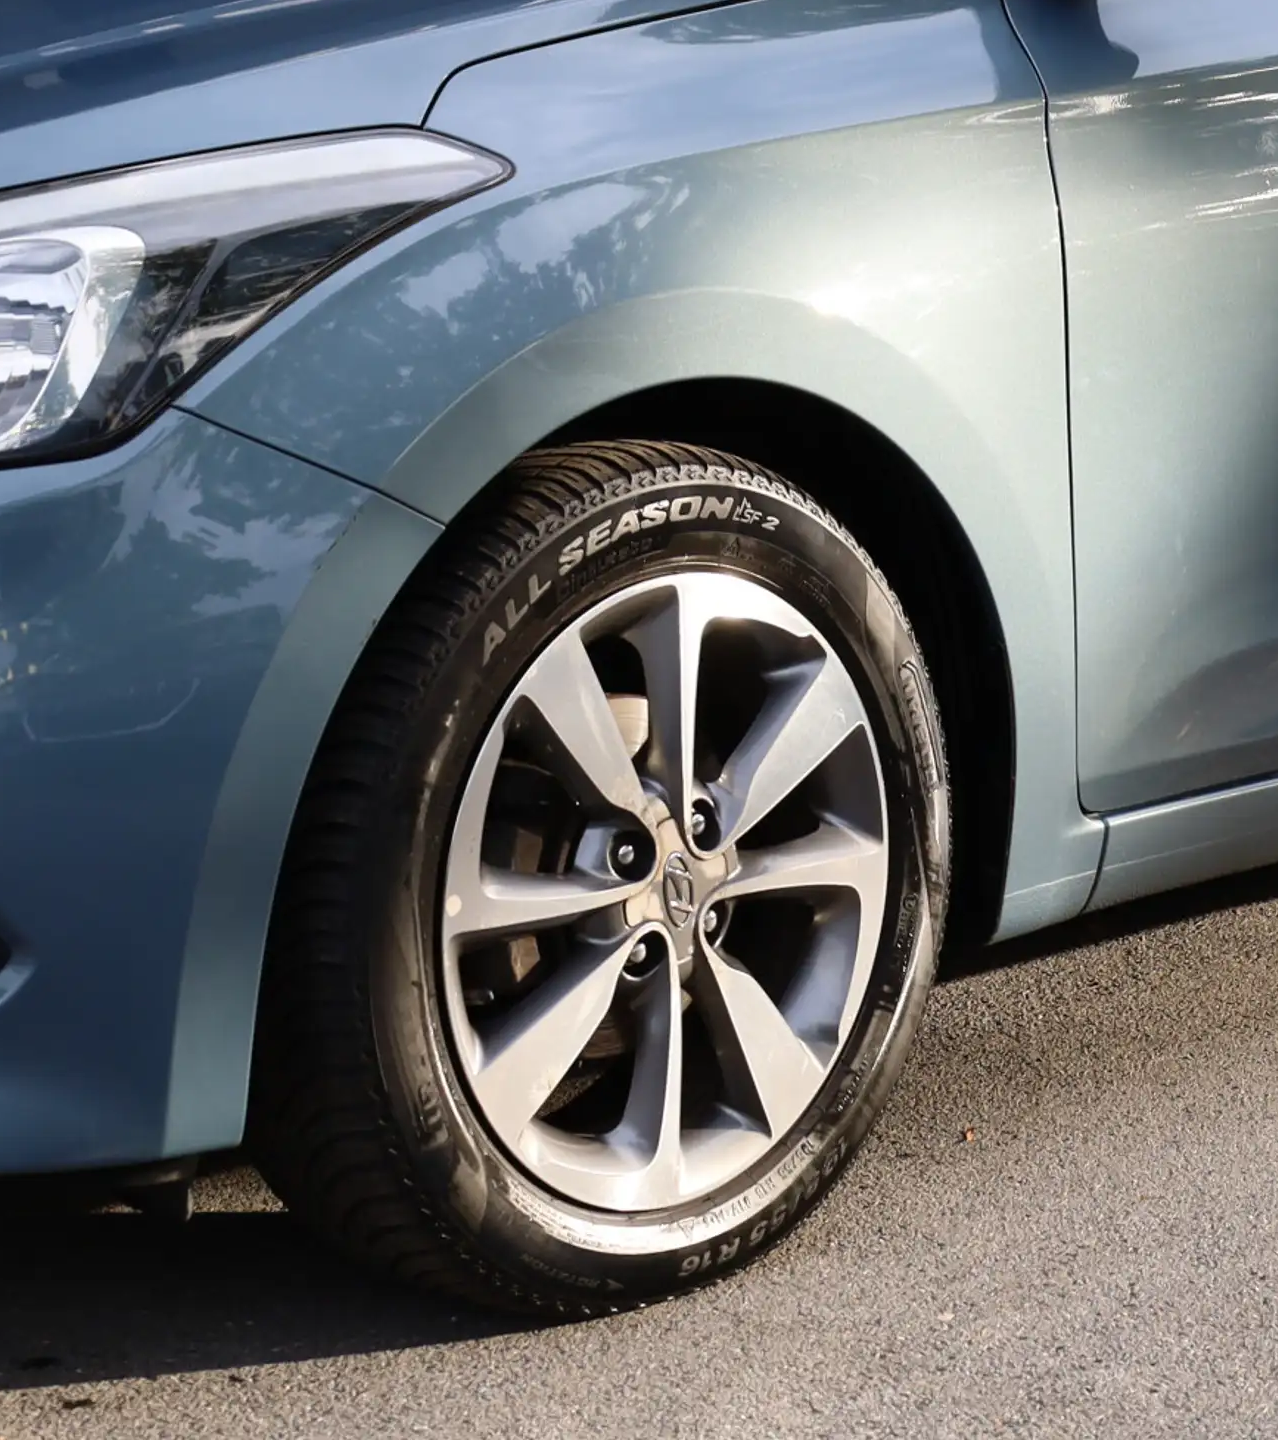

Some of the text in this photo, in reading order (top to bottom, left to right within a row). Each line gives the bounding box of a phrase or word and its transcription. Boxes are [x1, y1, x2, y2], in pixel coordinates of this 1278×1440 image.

[481, 572, 553, 667] ALL
[557, 495, 735, 577] SEASON
[761, 515, 781, 531] 2
